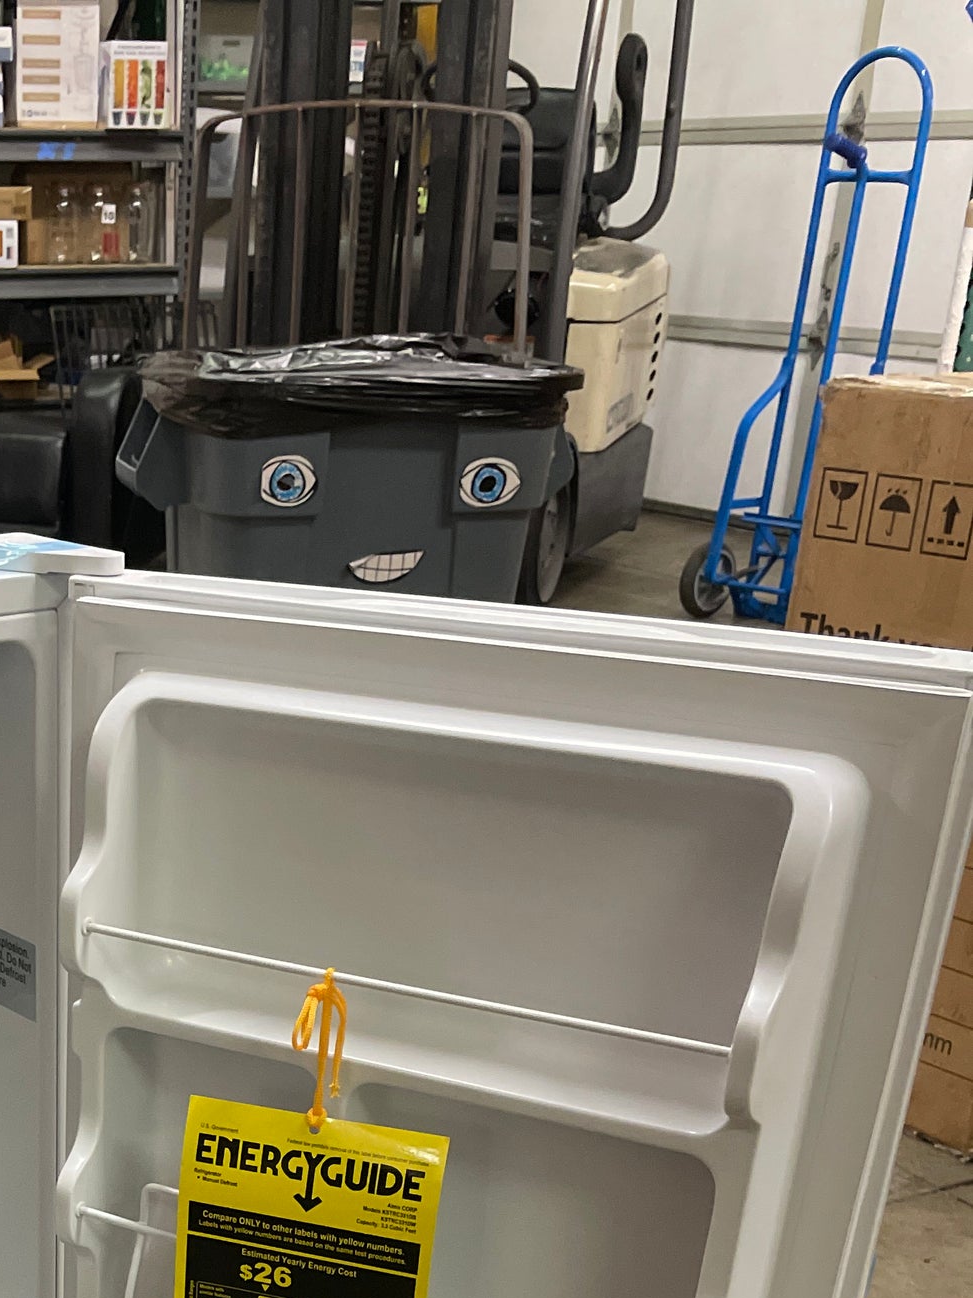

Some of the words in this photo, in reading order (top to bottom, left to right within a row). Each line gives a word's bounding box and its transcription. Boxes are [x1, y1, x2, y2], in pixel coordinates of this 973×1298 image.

[6, 951, 16, 966] Do
[18, 958, 31, 974] Not
[195, 1132, 426, 1202] ENERGYGUIDE
[198, 1219, 218, 1228] Labels
[220, 1223, 231, 1231] with
[232, 1225, 253, 1236] yellow
[254, 1230, 282, 1241] numbers
[294, 1238, 313, 1247] based
[324, 1244, 334, 1252] the
[335, 1247, 353, 1255] same
[354, 1250, 366, 1258] test
[367, 1252, 405, 1266] procedures.
[202, 1209, 237, 1225] Compare
[238, 1216, 260, 1228] ONLY
[262, 1222, 271, 1230] to
[272, 1223, 292, 1234] other
[294, 1227, 318, 1239] labels
[319, 1231, 337, 1243] with
[338, 1235, 365, 1249] yellow
[366, 1241, 404, 1255] numbers.
[239, 1262, 292, 1288] $26
[241, 1248, 280, 1263] Estimated
[281, 1256, 306, 1269] Yearly
[307, 1261, 336, 1275] Energy
[337, 1266, 356, 1278] Cost
